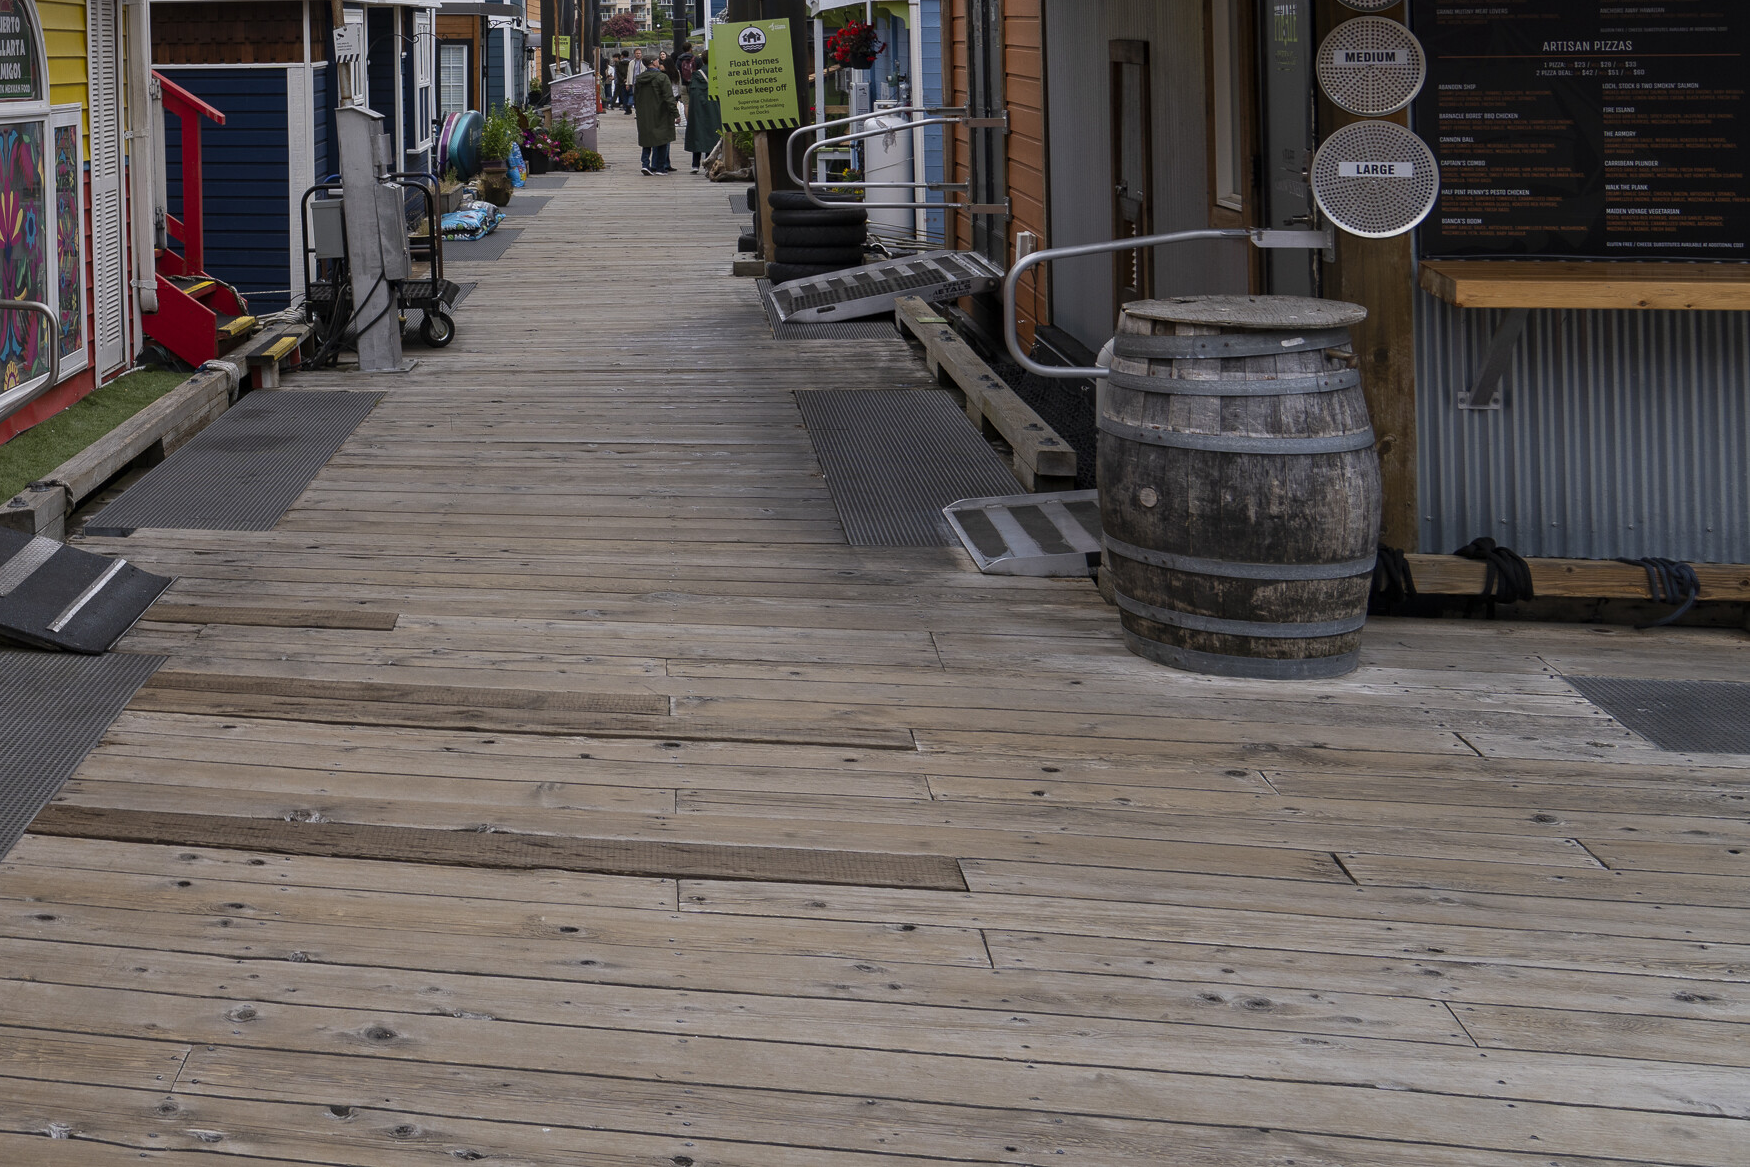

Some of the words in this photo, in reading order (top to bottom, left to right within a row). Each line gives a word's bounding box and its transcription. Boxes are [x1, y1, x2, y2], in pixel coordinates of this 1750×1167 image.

[1542, 41, 1590, 52] ARTISAN
[1594, 40, 1633, 51] PIZZAS
[1344, 50, 1397, 65] MEDIUM
[754, 66, 783, 75] private
[735, 77, 777, 85] residences
[21, 84, 31, 93] FOOD
[727, 87, 753, 97] please
[755, 86, 774, 94] keep
[1355, 162, 1396, 177] LARGE
